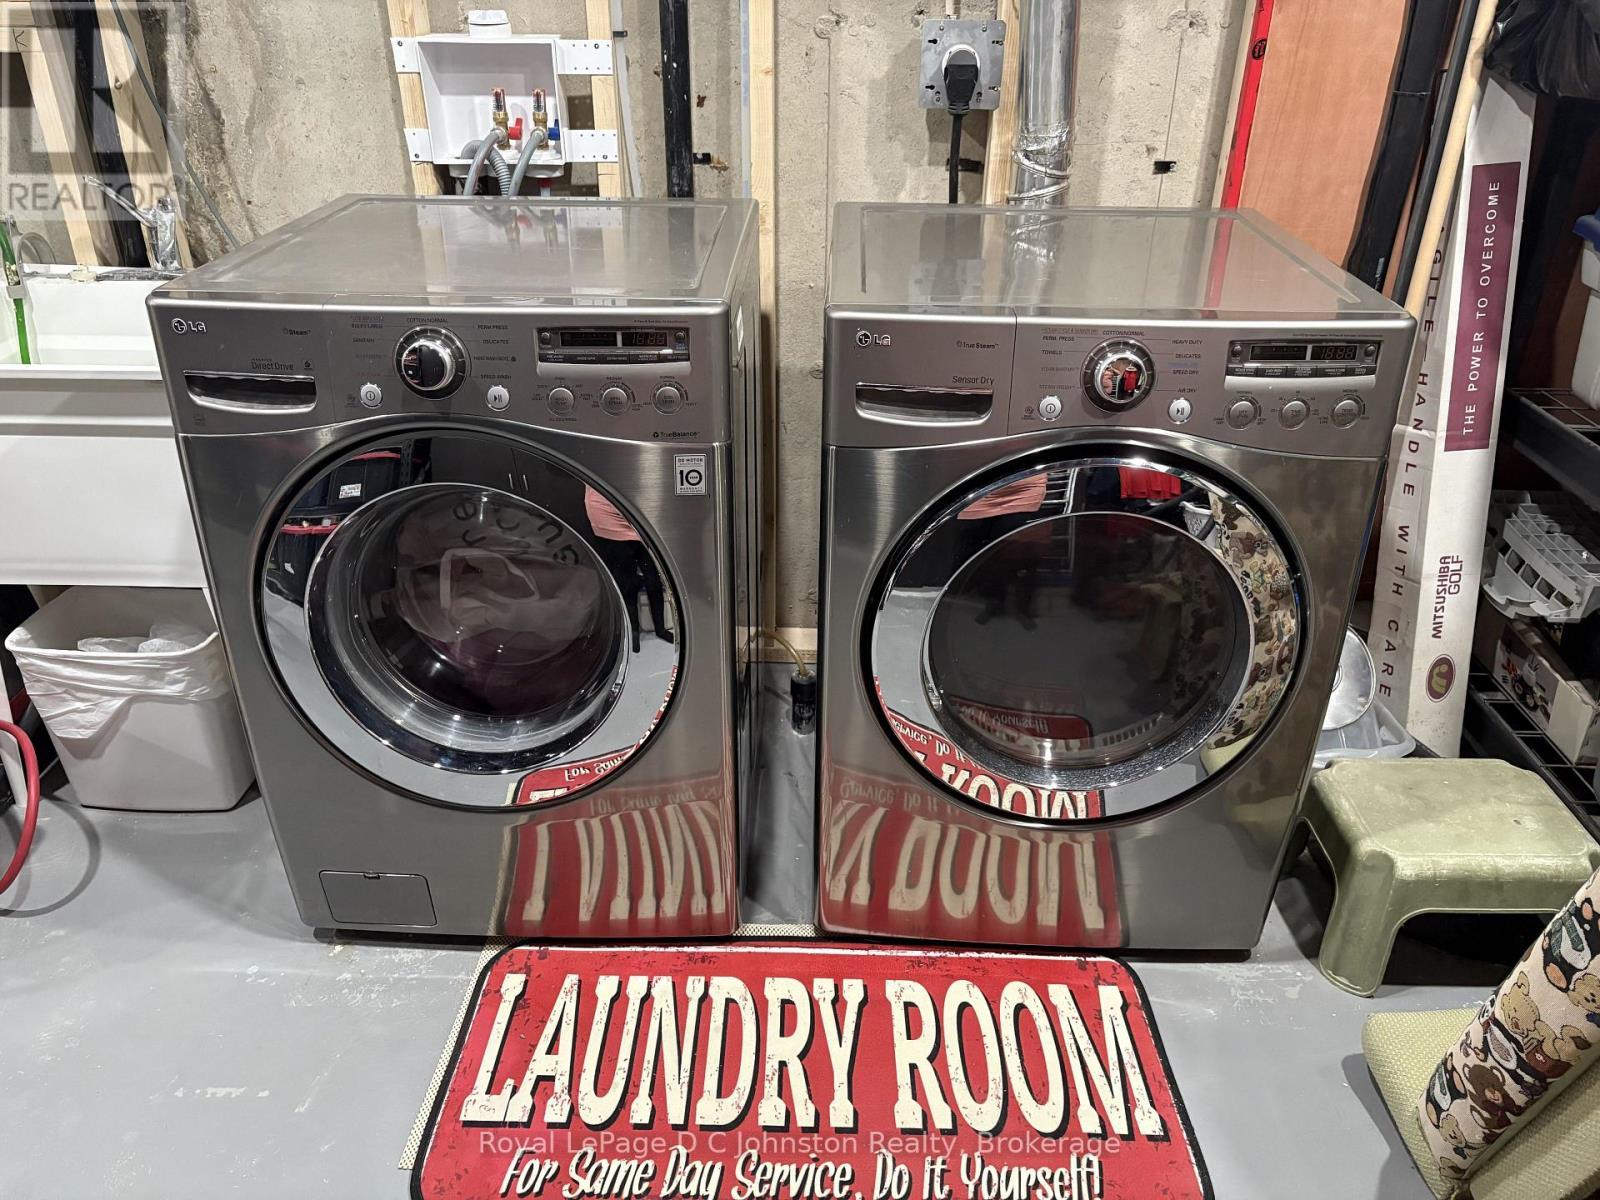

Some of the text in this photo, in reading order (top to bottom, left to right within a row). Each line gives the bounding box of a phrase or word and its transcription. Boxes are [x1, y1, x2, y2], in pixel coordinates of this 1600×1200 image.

[1463, 181, 1500, 435] THE POWER TO OVERCOME
[952, 375, 994, 386] Sensor Dry
[1402, 372, 1429, 496] HANDLE
[680, 469, 702, 486] 10
[1392, 524, 1410, 597] WITH
[1431, 555, 1452, 639] MITSUSHIBA
[1447, 554, 1463, 595] GOLF
[1379, 619, 1400, 698] CARE
[459, 973, 1168, 1138] LAUNDRY ROOM
[499, 1146, 561, 1198] For
[562, 1146, 656, 1199] Same
[659, 1144, 724, 1200] Day
[872, 1148, 912, 1200] Do
[922, 1155, 951, 1200] It
